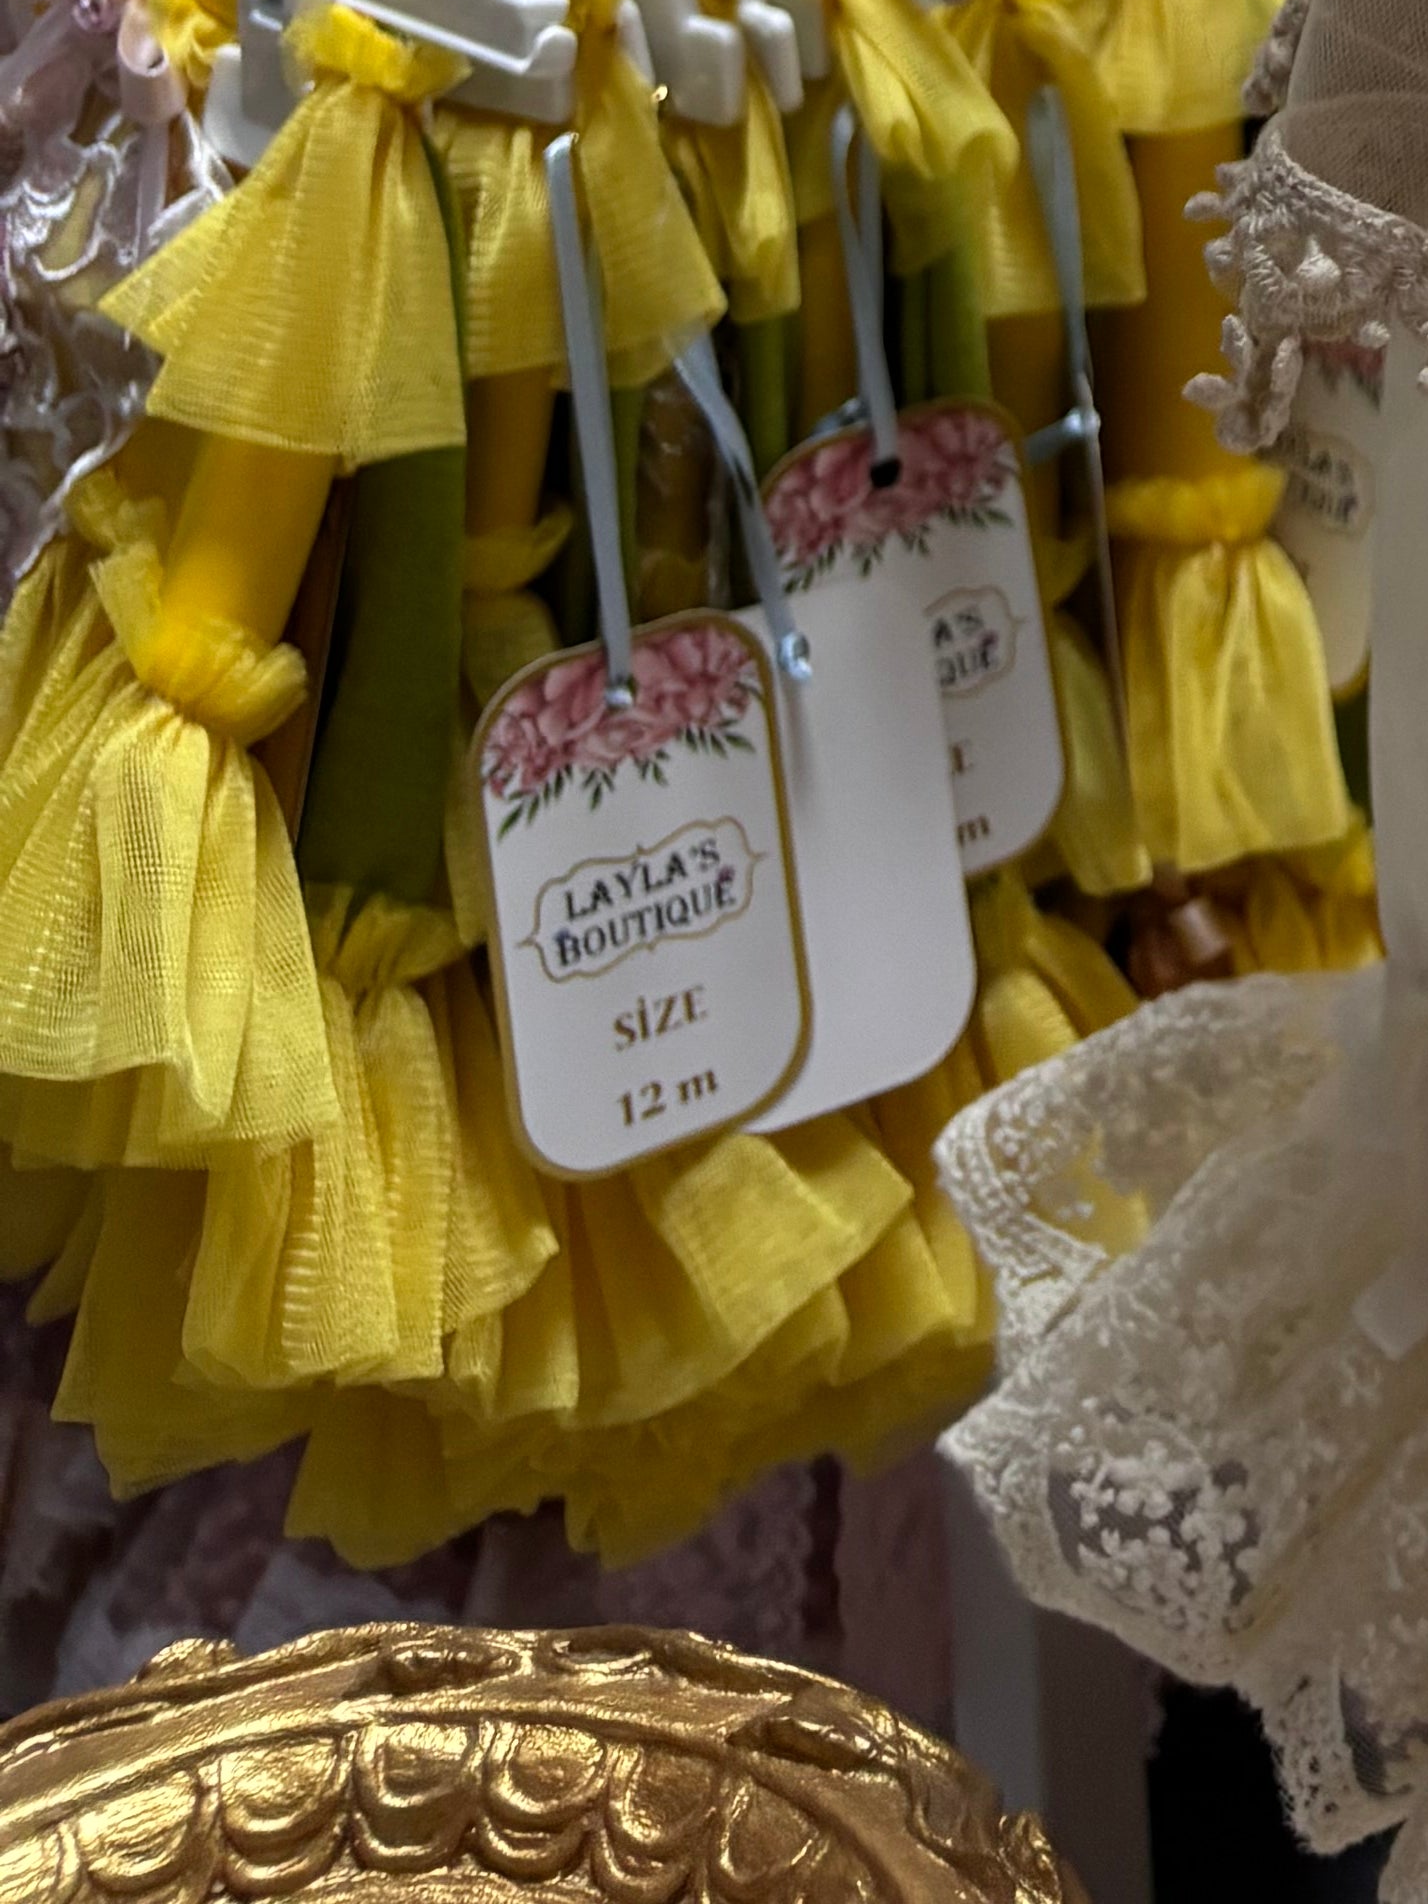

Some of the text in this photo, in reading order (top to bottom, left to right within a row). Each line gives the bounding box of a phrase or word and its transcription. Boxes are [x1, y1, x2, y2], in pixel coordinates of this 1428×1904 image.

[557, 877, 736, 966] BOUTIQUE
[564, 838, 720, 922] LAYLA'S
[617, 1069, 718, 1127] 12 m
